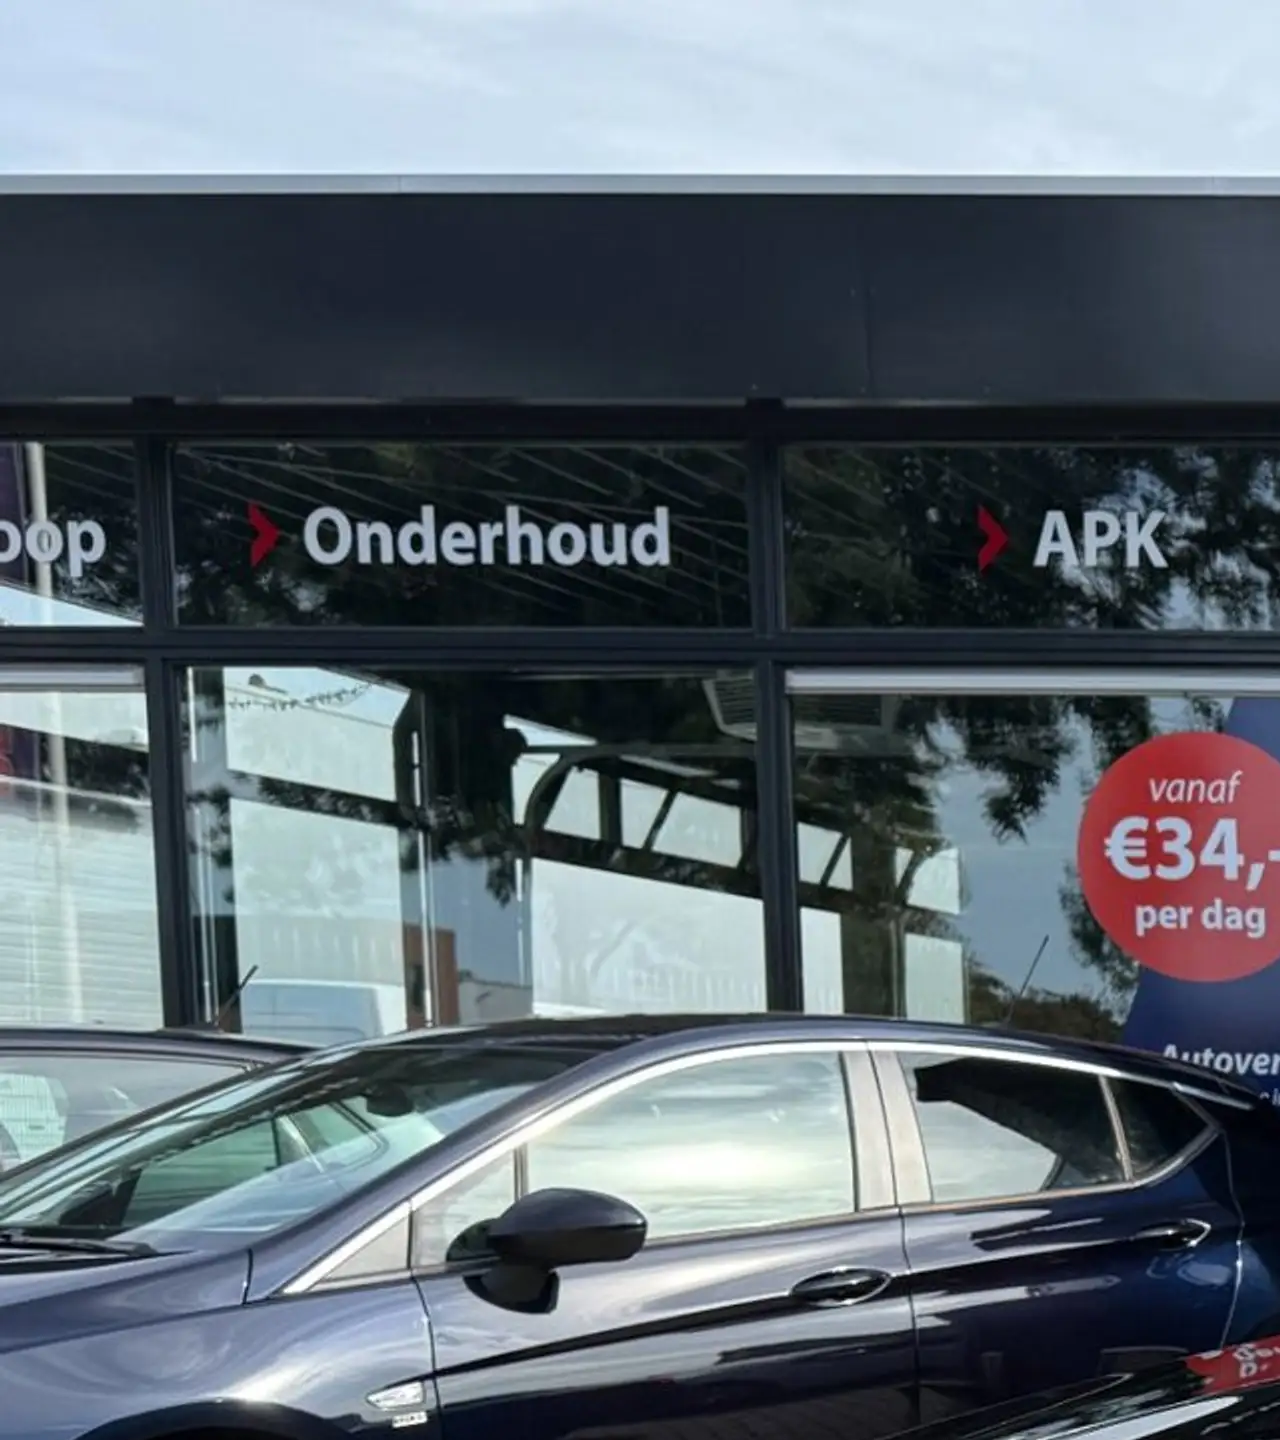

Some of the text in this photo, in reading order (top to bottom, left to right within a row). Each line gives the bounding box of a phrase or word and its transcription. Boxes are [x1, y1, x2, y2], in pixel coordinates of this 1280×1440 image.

[303, 505, 670, 566] Onderhoud
[1033, 510, 1168, 568] APK
[1149, 771, 1243, 804] vanaf
[1135, 899, 1266, 938] per dag
